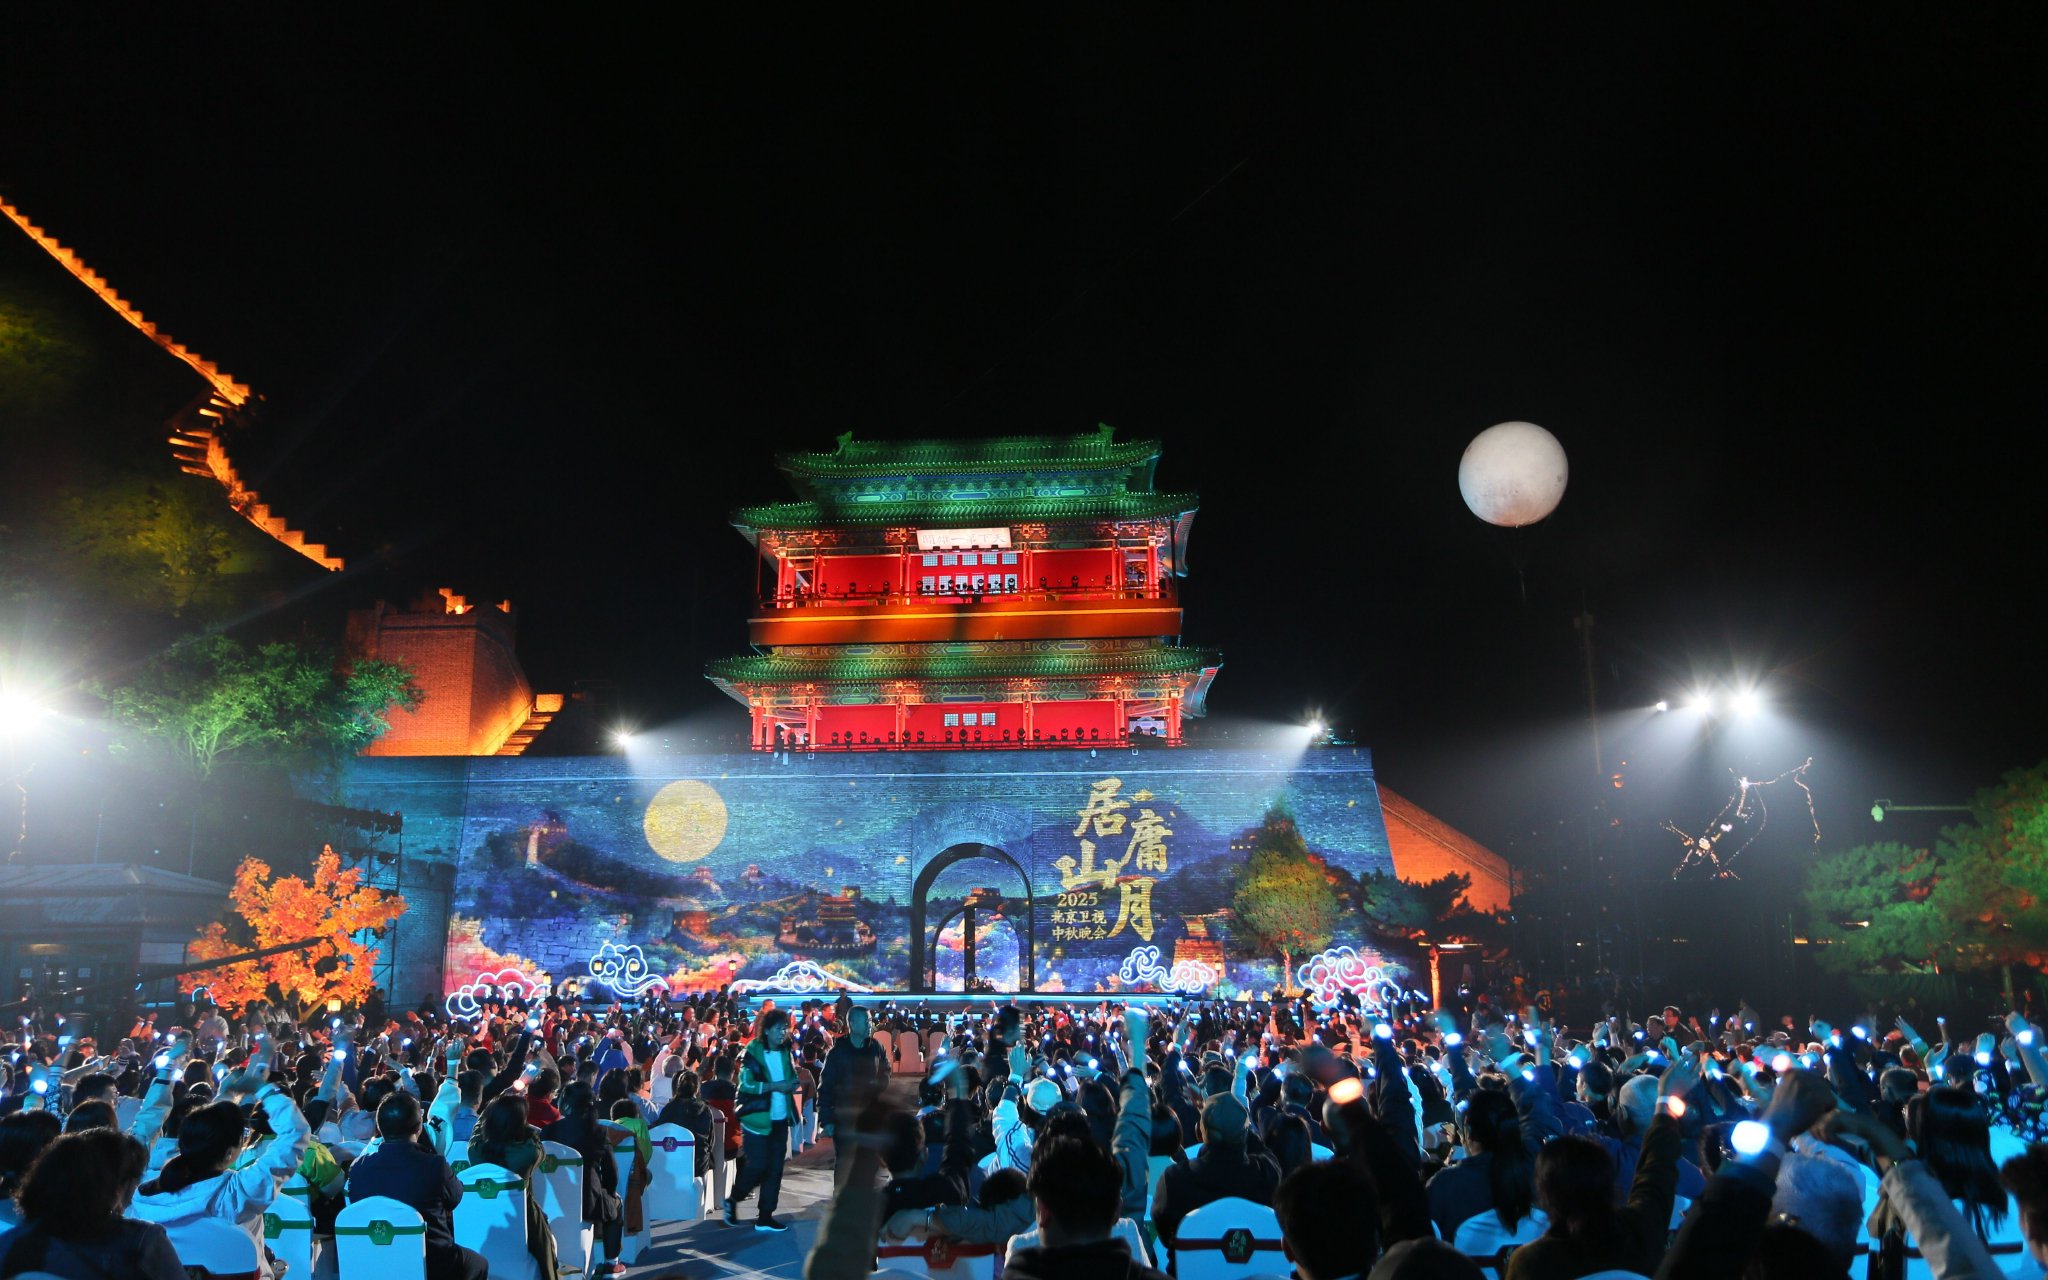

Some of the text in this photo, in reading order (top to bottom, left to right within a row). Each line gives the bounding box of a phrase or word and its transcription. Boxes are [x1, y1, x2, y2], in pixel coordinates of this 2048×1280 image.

[1057, 892, 1098, 907] 2025
[1051, 910, 1107, 925] 北京卫视
[1052, 926, 1108, 942] 中秋晚会
